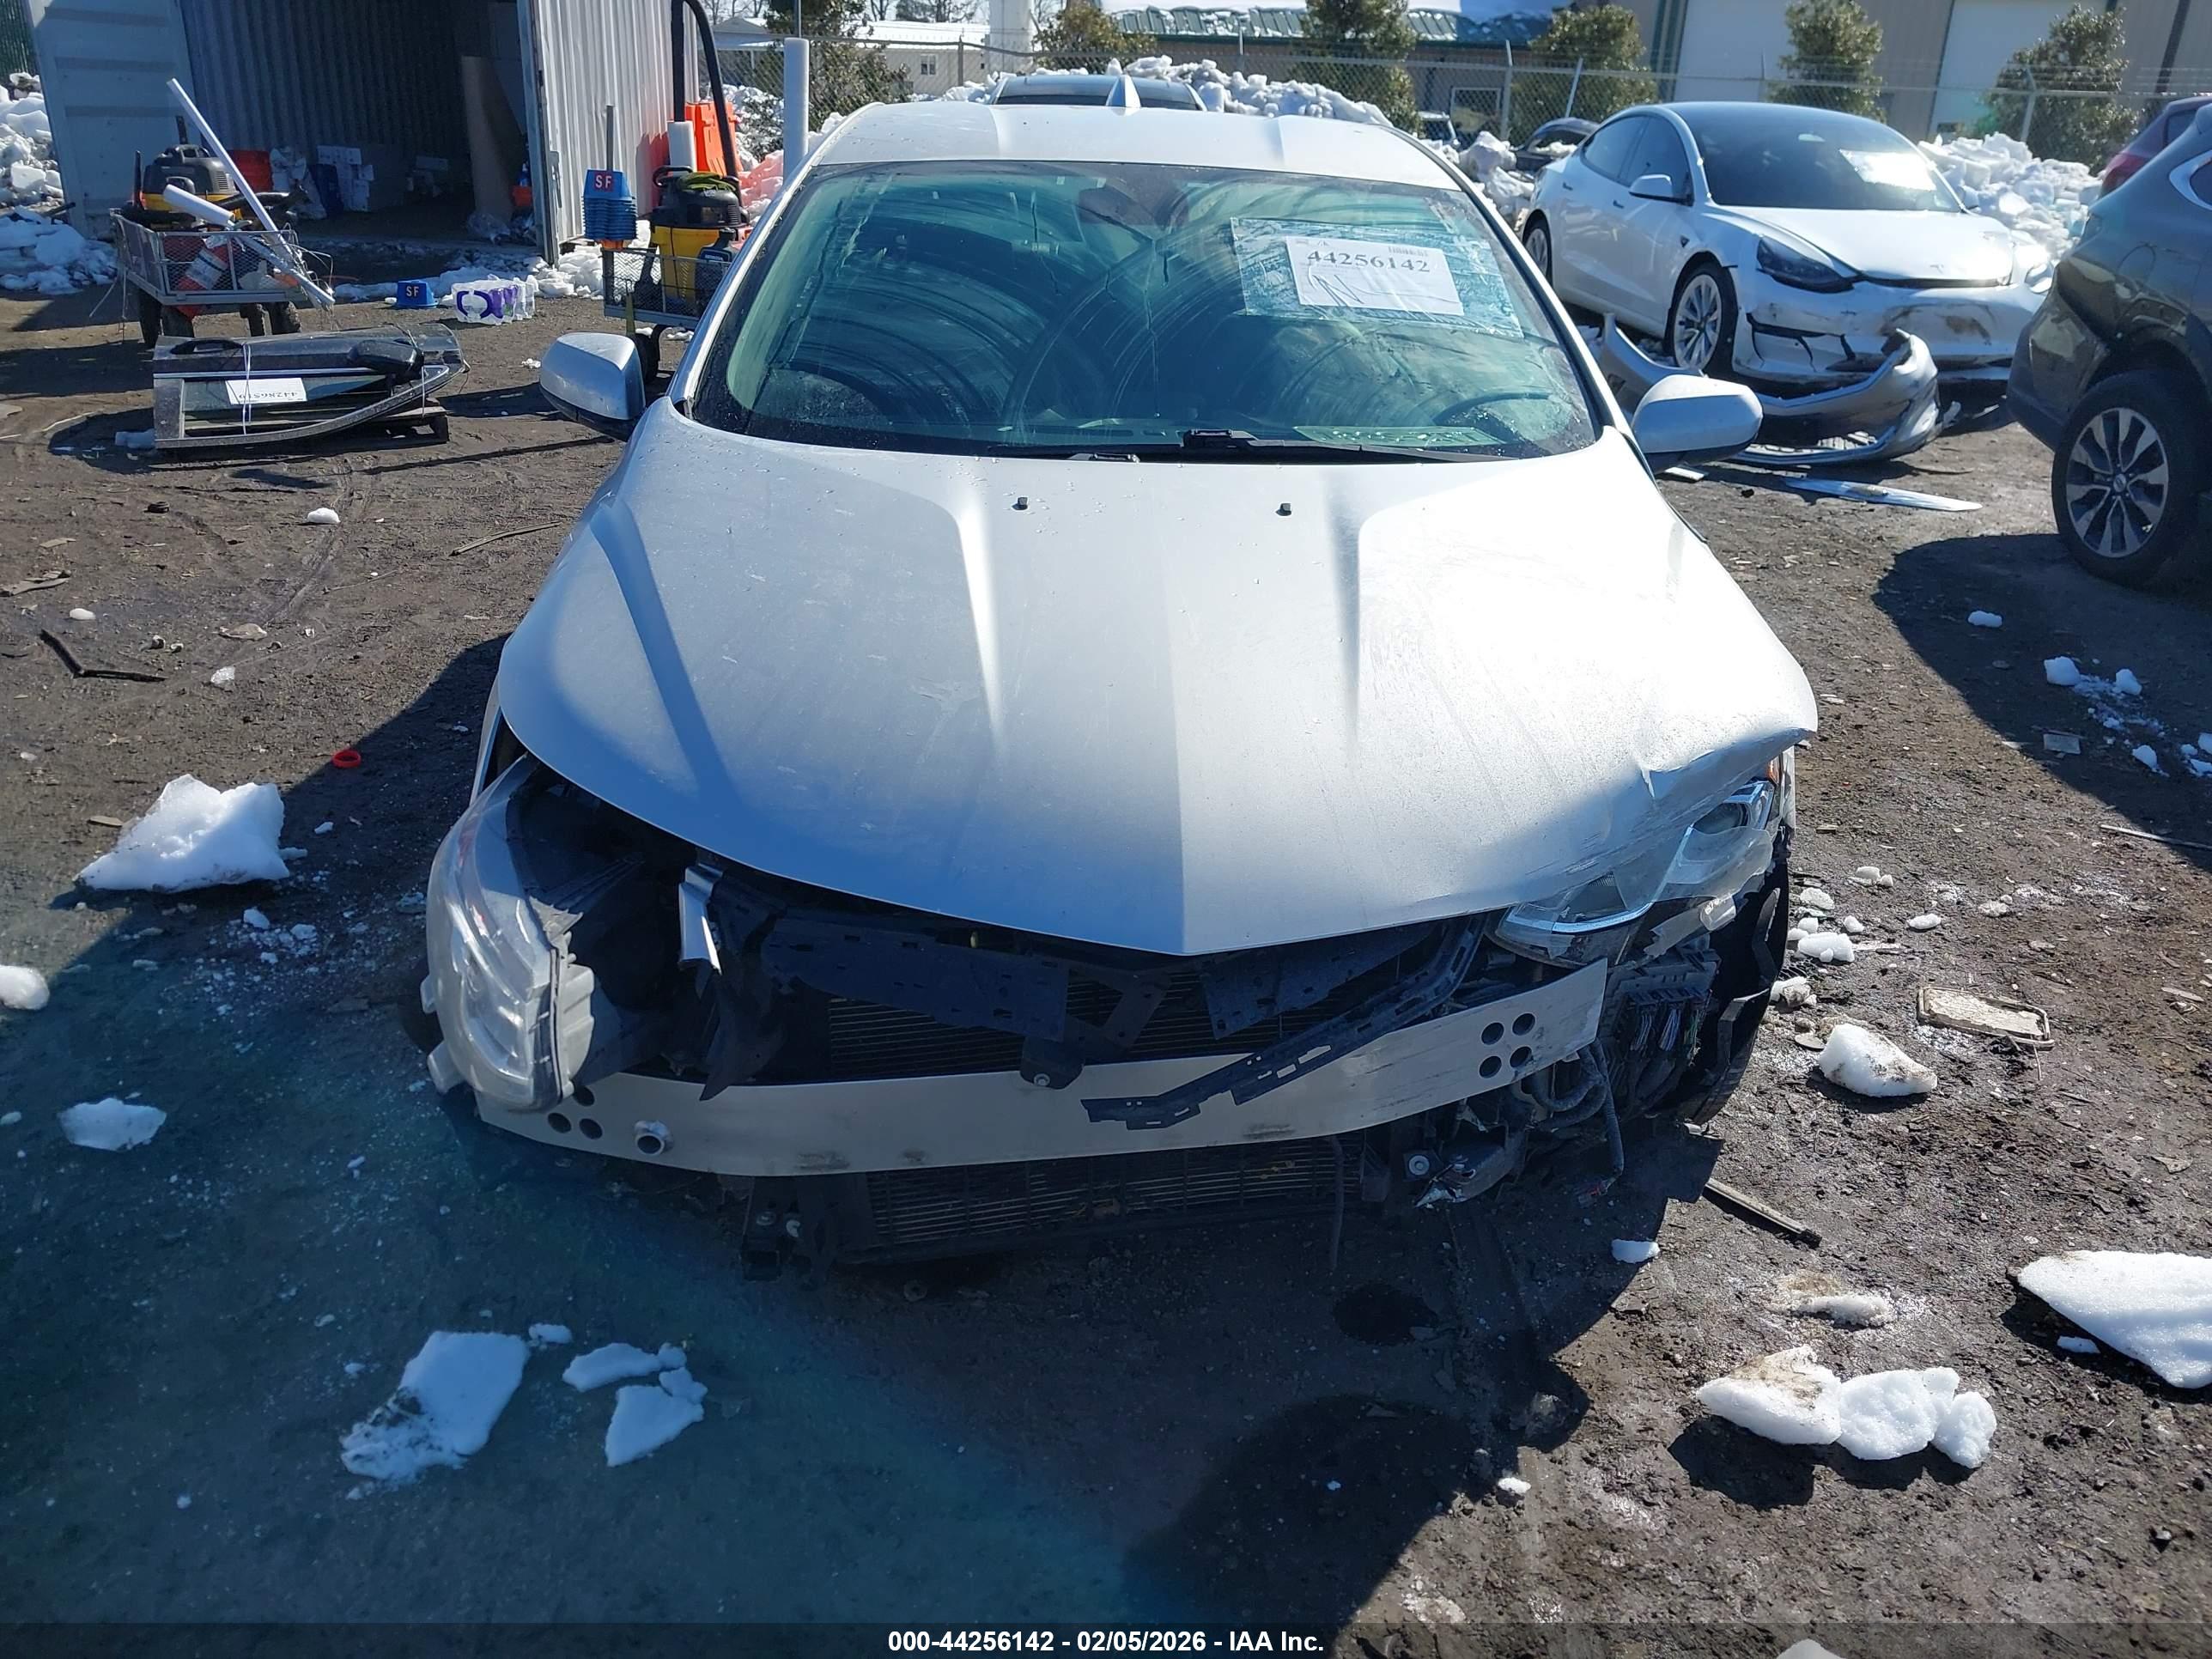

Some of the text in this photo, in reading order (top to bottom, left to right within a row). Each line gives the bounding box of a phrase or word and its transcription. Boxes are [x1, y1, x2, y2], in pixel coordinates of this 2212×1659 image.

[595, 174, 612, 189] SF
[1307, 250, 1431, 273] 44256142
[406, 285, 420, 297] SF
